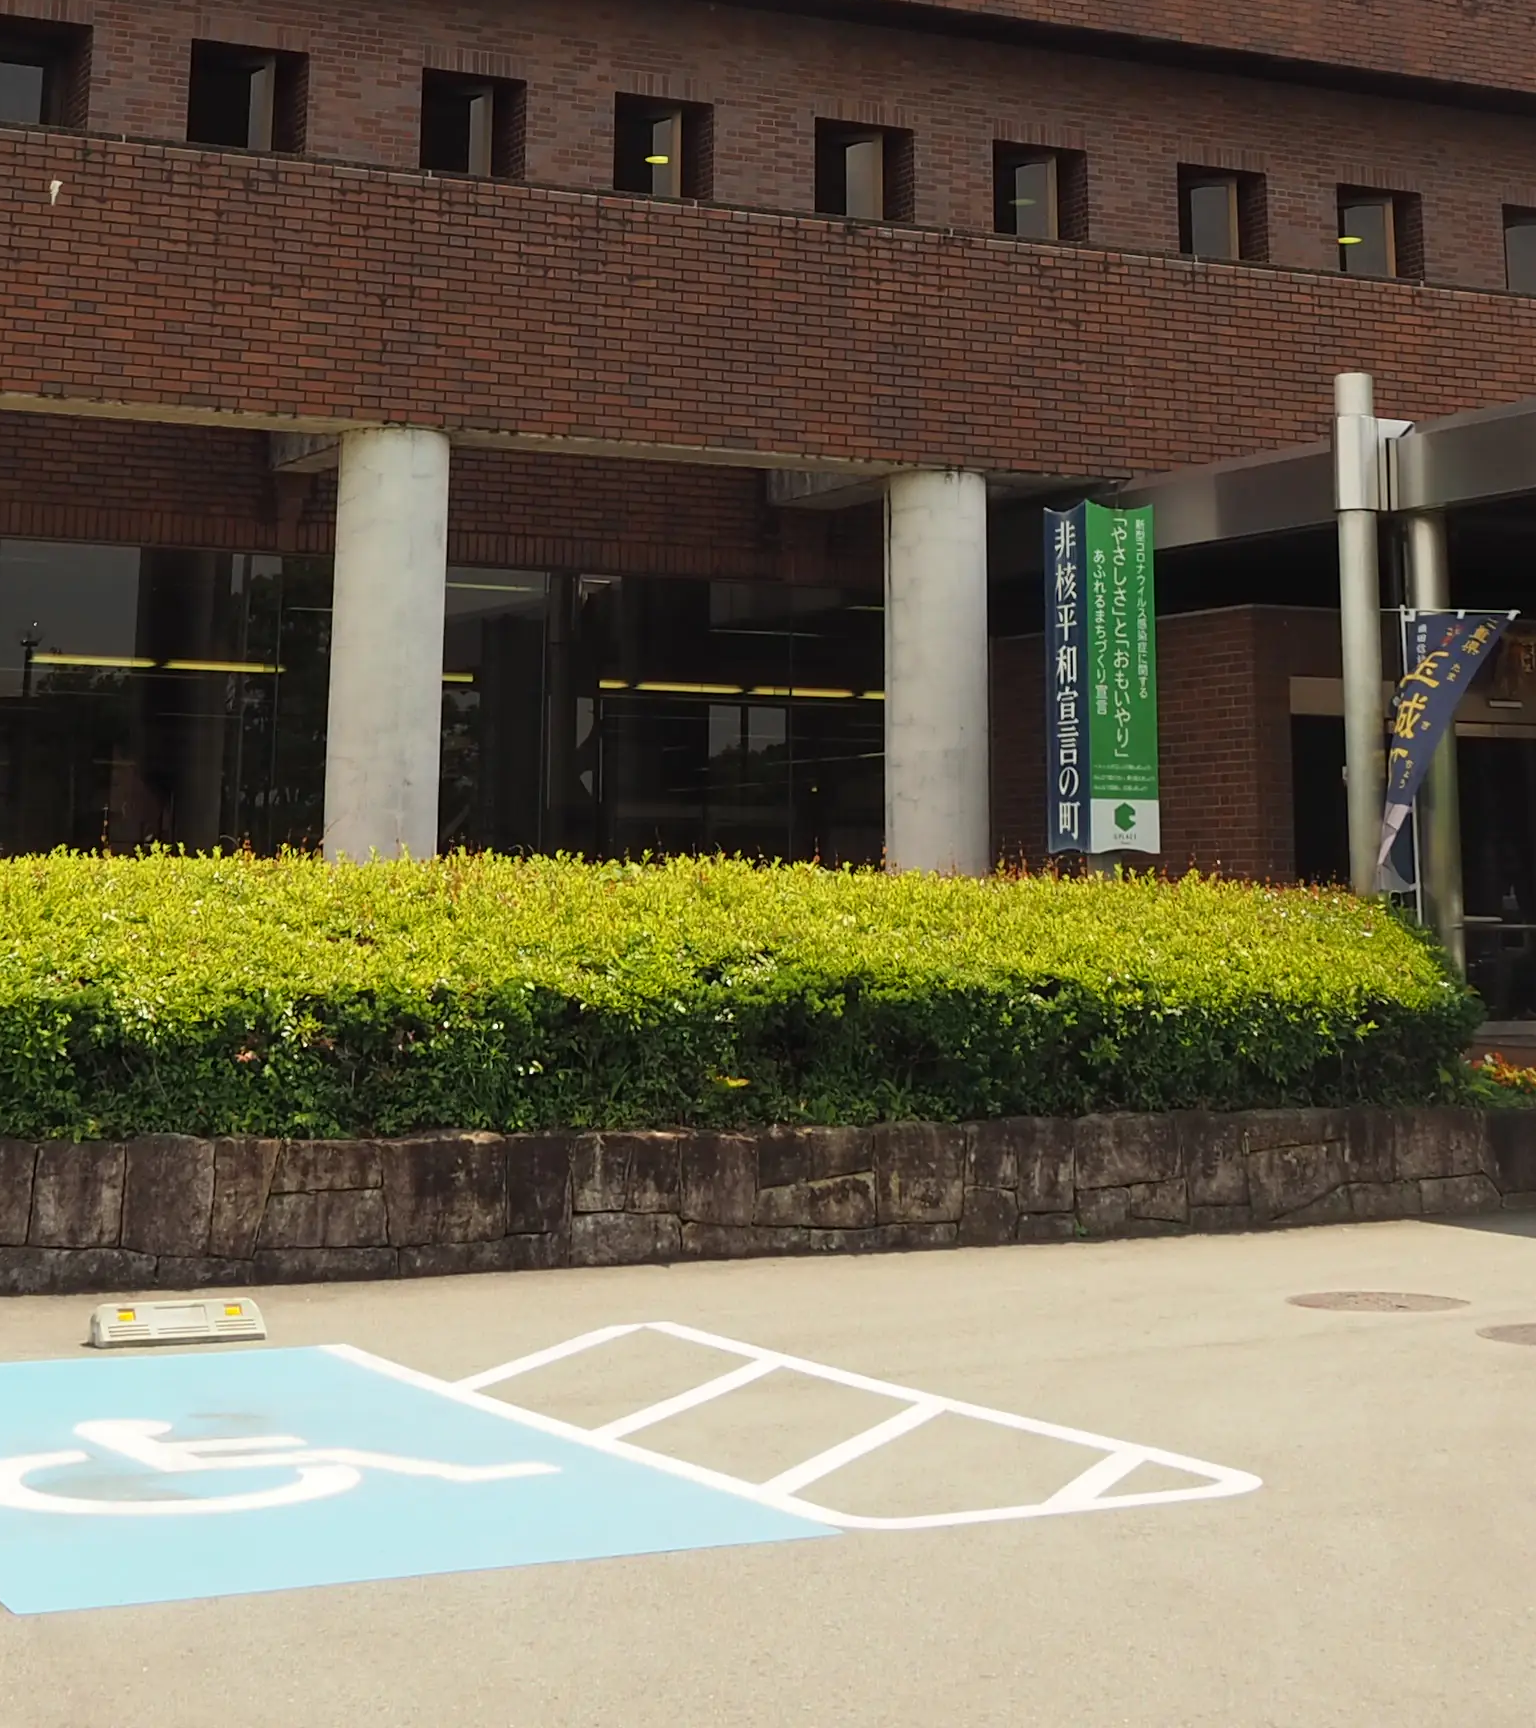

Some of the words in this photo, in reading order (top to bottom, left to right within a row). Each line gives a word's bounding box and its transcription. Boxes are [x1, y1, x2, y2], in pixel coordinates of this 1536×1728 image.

[1054, 520, 1082, 841] 非核平和宣言の町
[1093, 548, 1108, 716] あふれるまちづくり宣言
[1111, 518, 1132, 758] 「やさしさ」と「おもいやり」
[1134, 519, 1150, 699] 新型コロナウイルス感染症に関する
